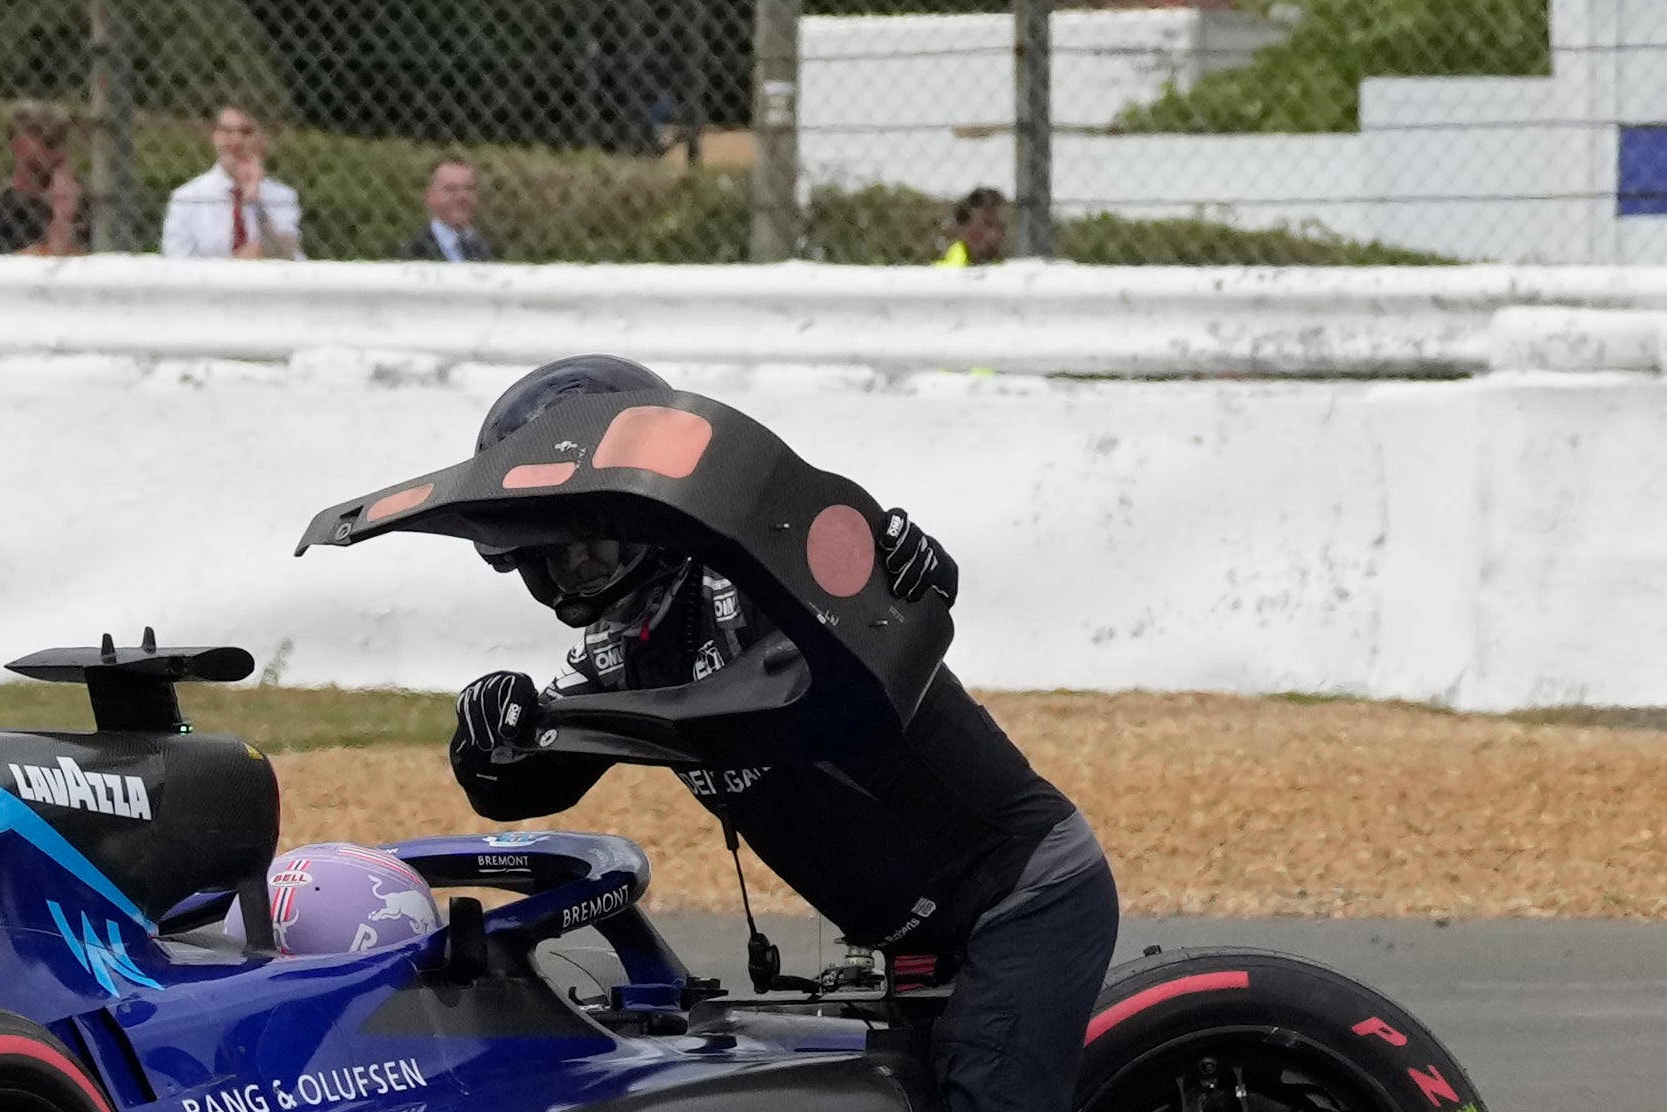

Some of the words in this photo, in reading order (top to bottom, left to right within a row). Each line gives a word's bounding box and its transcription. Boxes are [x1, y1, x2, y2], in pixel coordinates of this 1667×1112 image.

[715, 596, 737, 618] OM
[595, 651, 625, 671] OM
[8, 756, 152, 821] LAVAZZA
[477, 855, 530, 867] BREMONT
[273, 873, 308, 883] BELL
[562, 884, 630, 929] BREMONT
[1351, 1016, 1409, 1047] P
[273, 1079, 297, 1111] &
[298, 1058, 428, 1106] OLUFSEN
